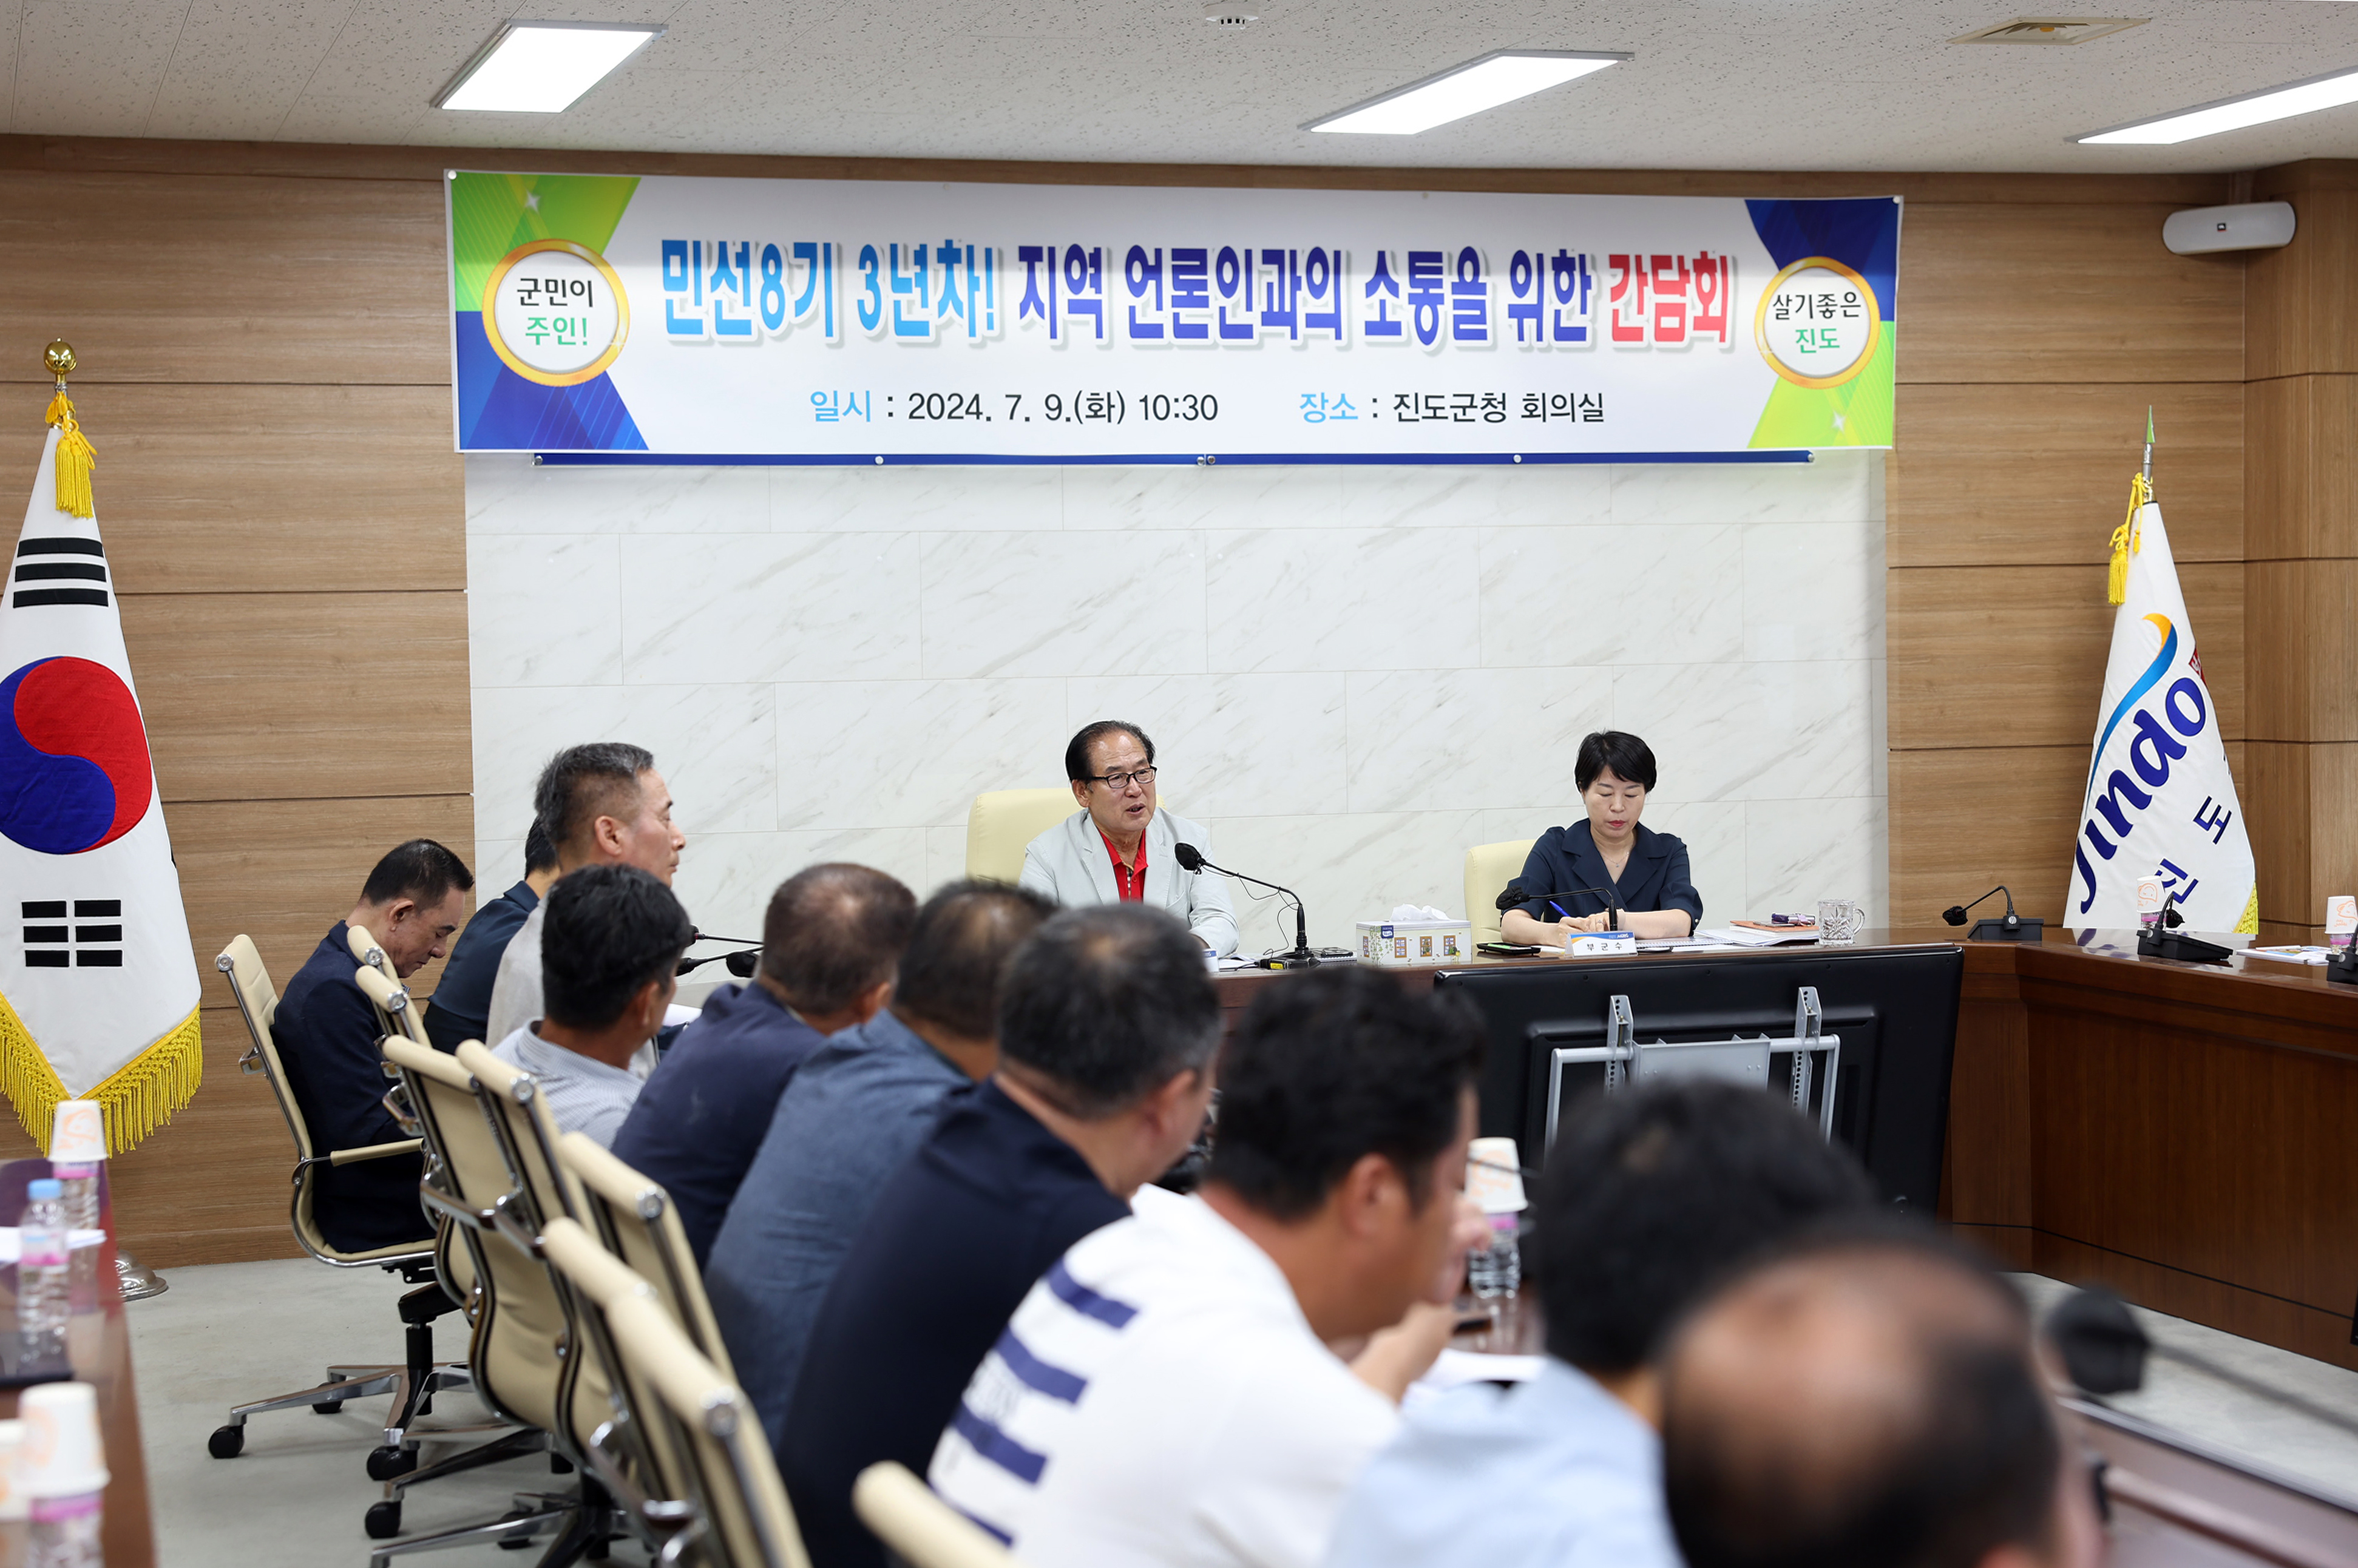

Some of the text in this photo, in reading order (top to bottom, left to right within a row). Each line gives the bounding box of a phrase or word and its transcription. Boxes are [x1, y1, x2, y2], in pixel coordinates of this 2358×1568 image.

[517, 278, 593, 308] 군민이
[662, 239, 1729, 346] 민선8기 3년차! 지역 언론인과의 소통을 위한 간담회
[1772, 291, 1862, 320] 살기좋은
[525, 317, 588, 346] 주인!
[1795, 328, 1840, 354] 진도
[810, 390, 872, 423] 일시
[908, 392, 992, 422] 2024.
[1005, 394, 1031, 422] 7.
[1045, 389, 1126, 425] 9.(화)
[1139, 393, 1219, 421] 10:30
[1299, 391, 1360, 424] 장소
[1393, 391, 1508, 423] 진도군청
[1520, 391, 1605, 423] 회의실
[2075, 677, 2206, 914] Jindo
